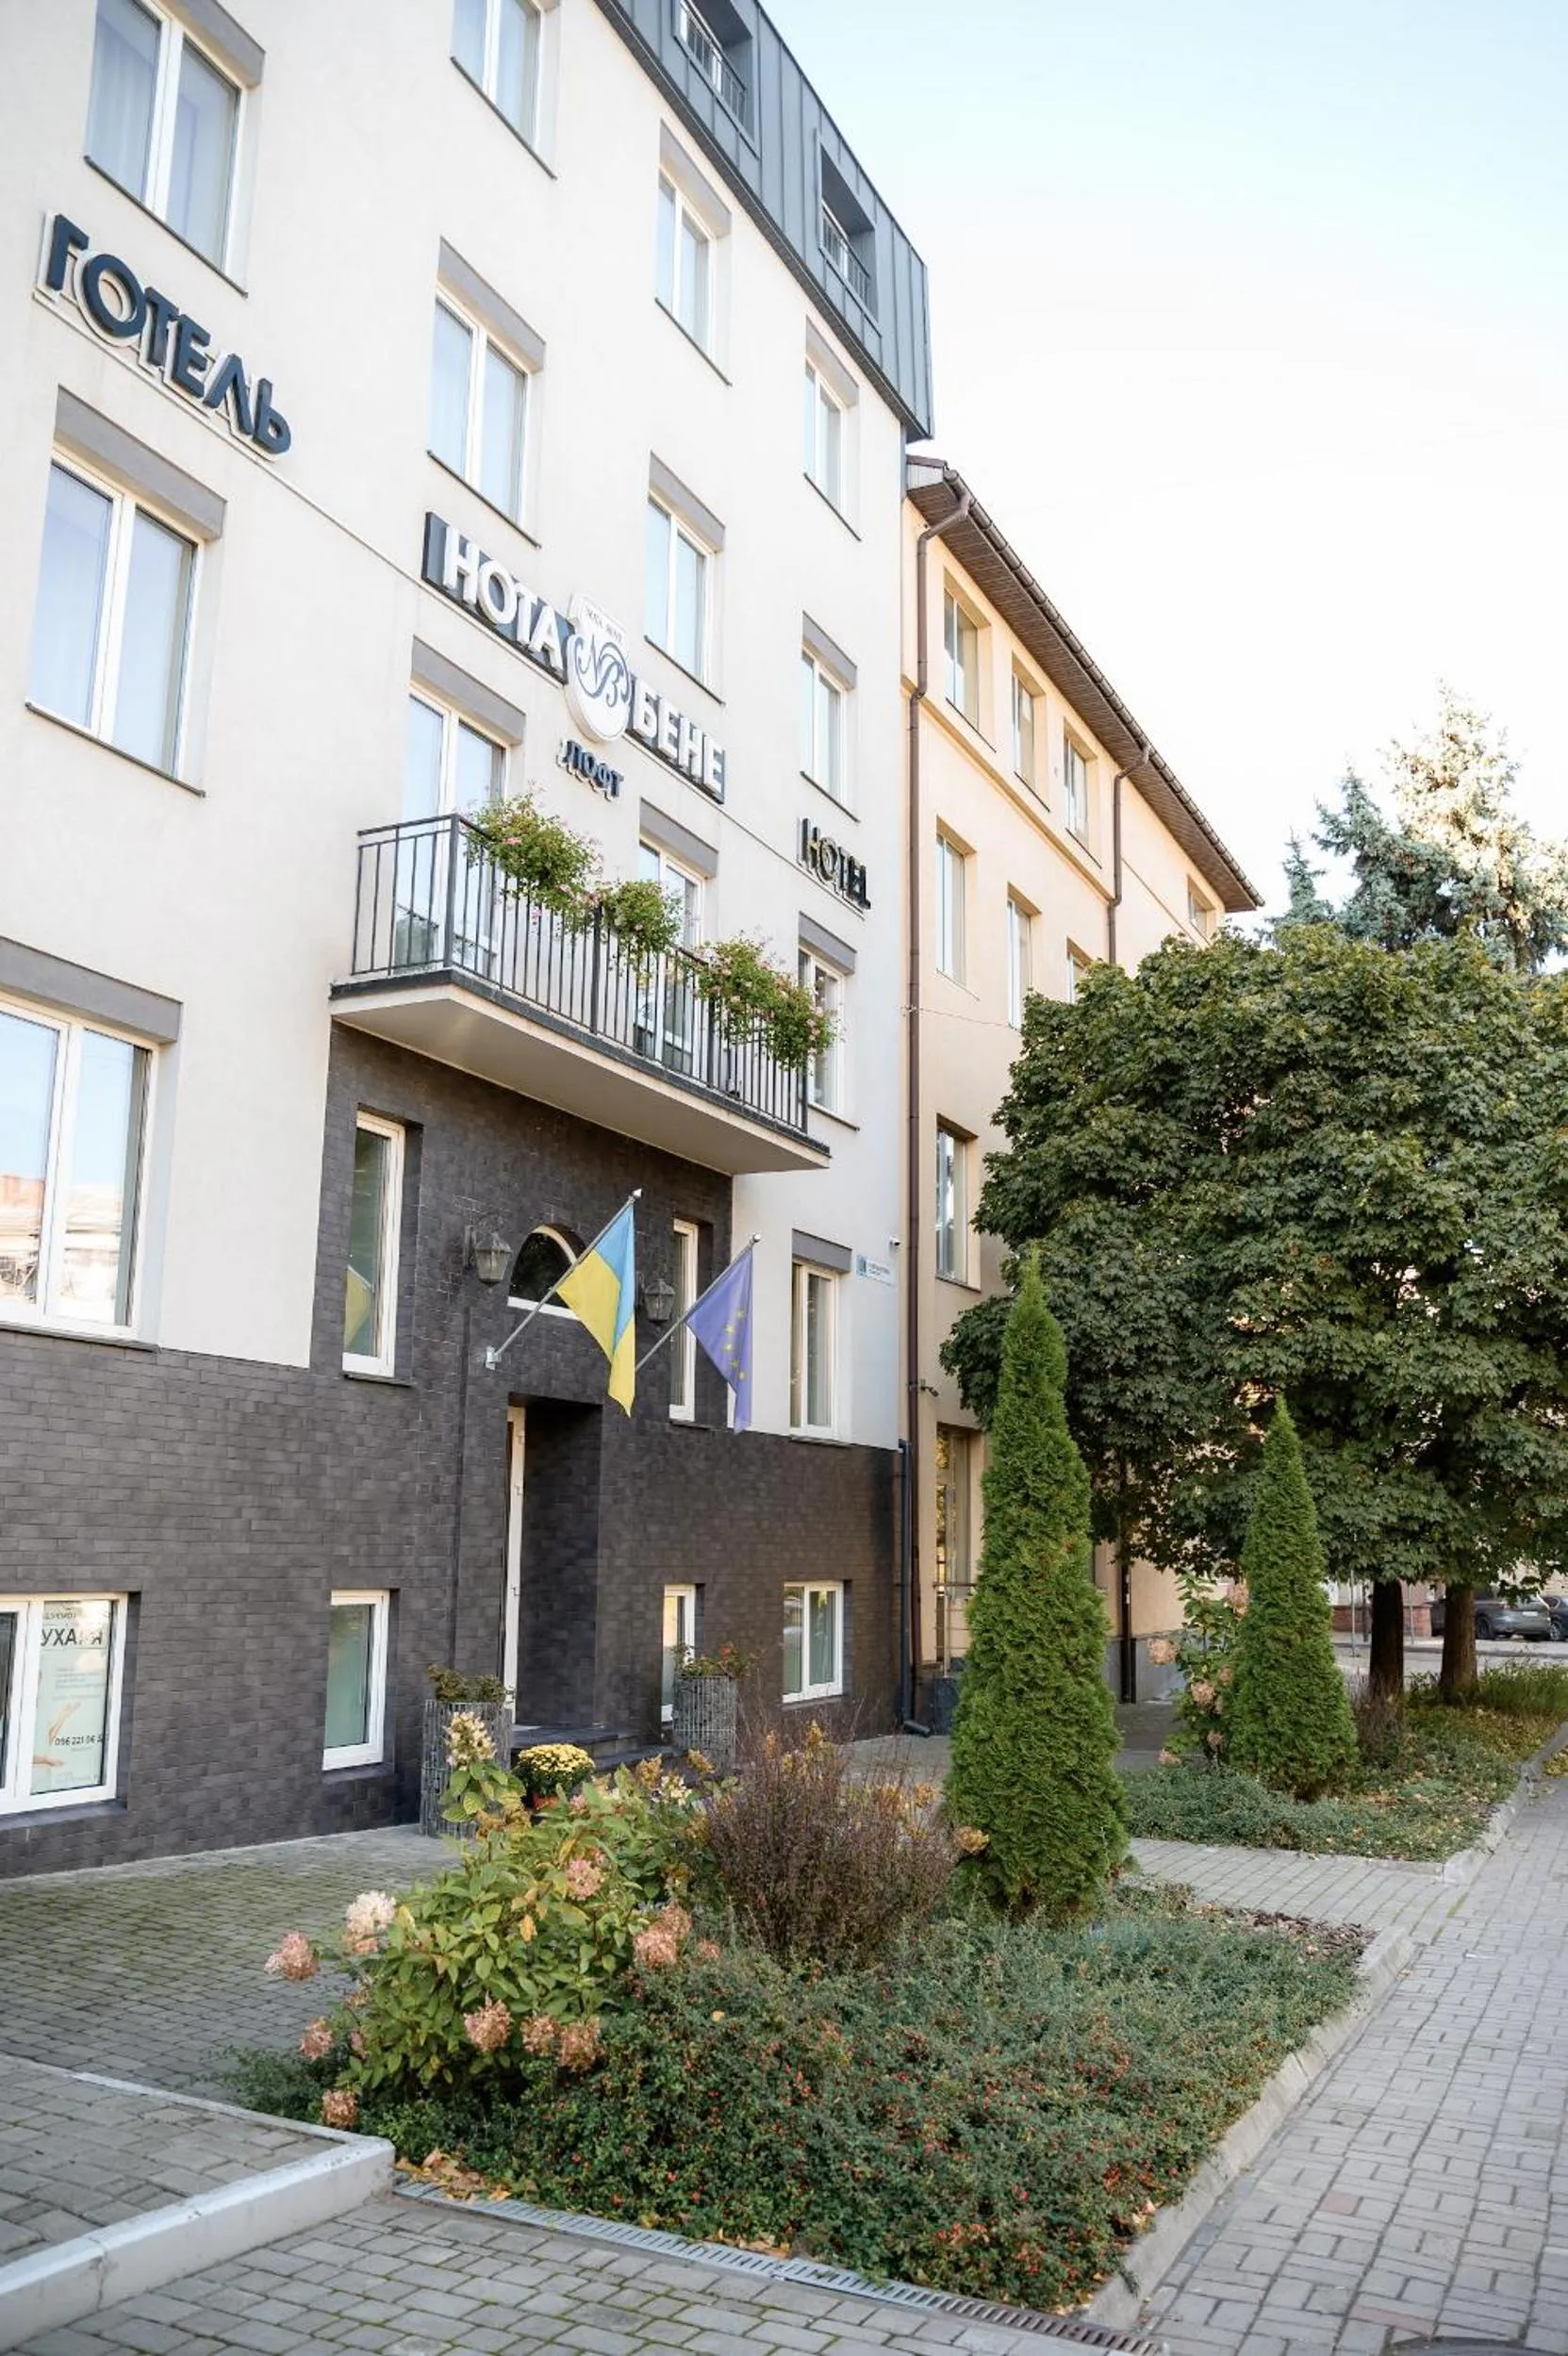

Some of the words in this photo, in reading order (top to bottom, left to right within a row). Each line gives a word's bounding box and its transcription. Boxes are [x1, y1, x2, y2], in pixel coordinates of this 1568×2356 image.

[44, 213, 292, 454] ГОТЕЛЬ
[442, 525, 566, 672] НОТА
[632, 676, 726, 799] БЕНЕ
[801, 817, 871, 910] HOTEL
